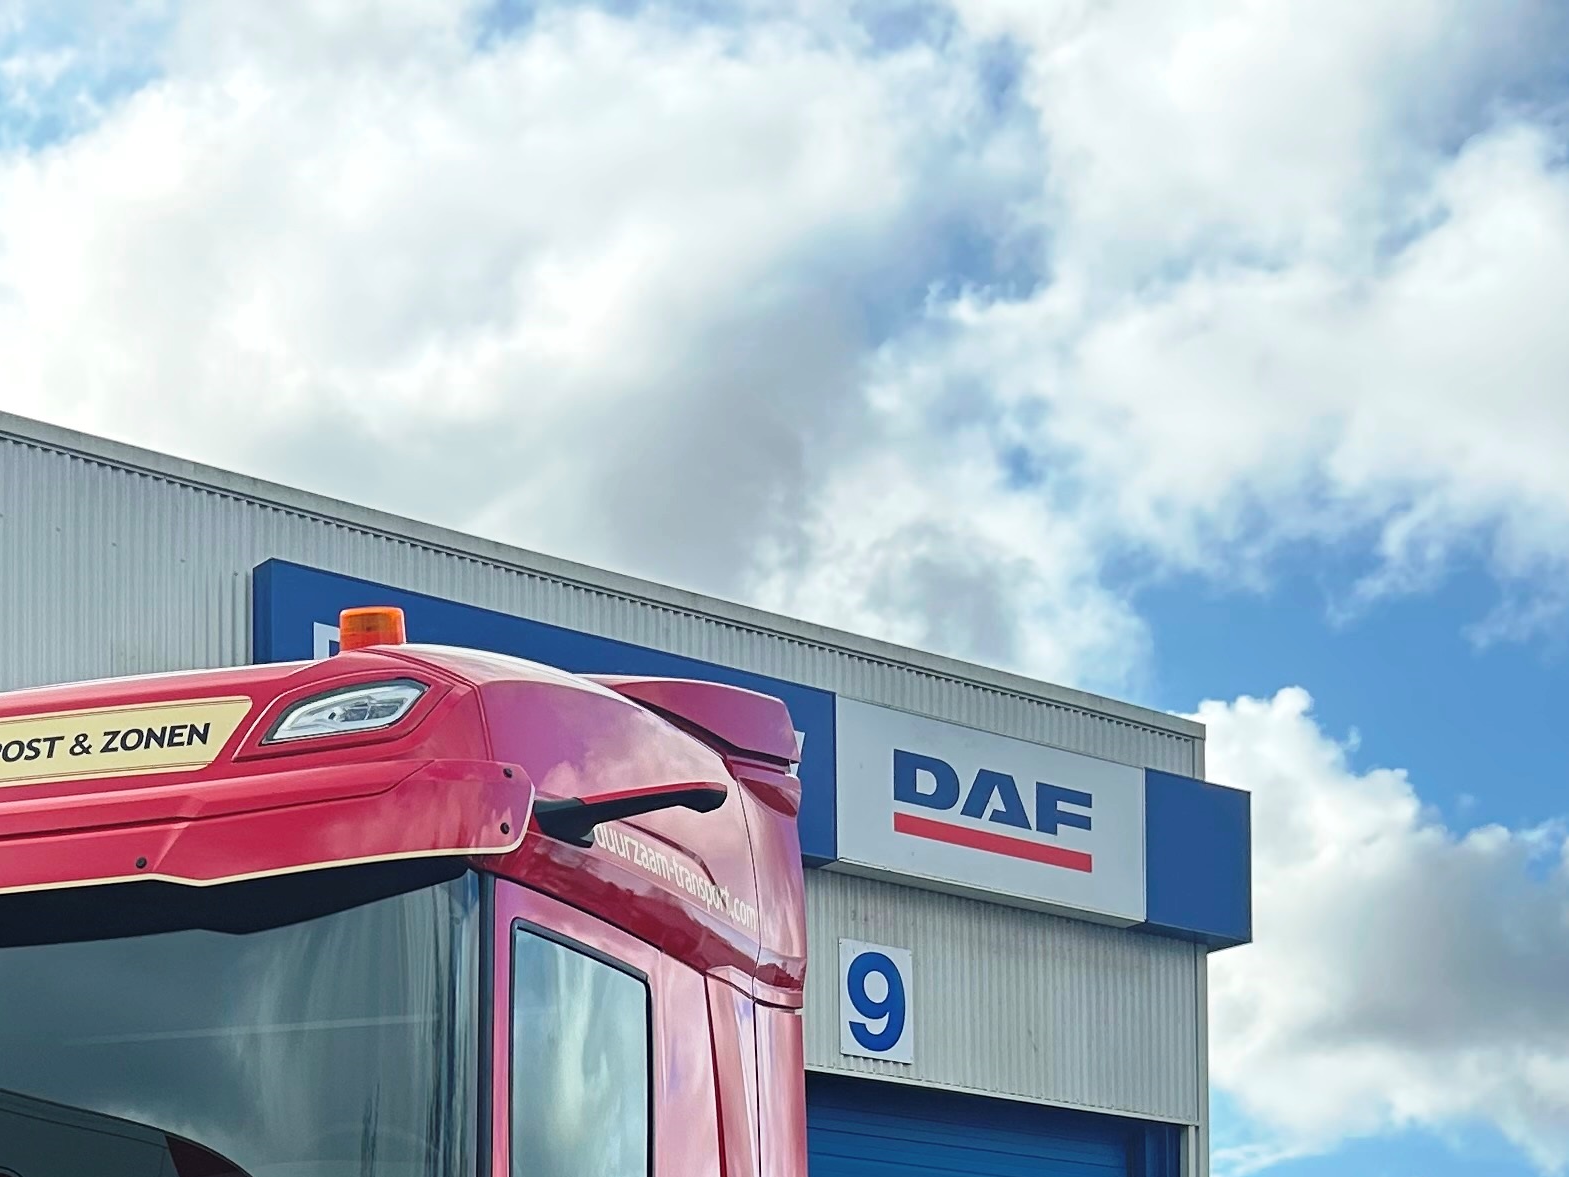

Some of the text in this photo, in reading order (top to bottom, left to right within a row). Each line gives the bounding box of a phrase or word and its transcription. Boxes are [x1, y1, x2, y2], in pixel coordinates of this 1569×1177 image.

[69, 733, 92, 756] &
[100, 722, 211, 753] ZONEN
[894, 748, 1092, 836] DAF
[847, 951, 906, 1052] 9
